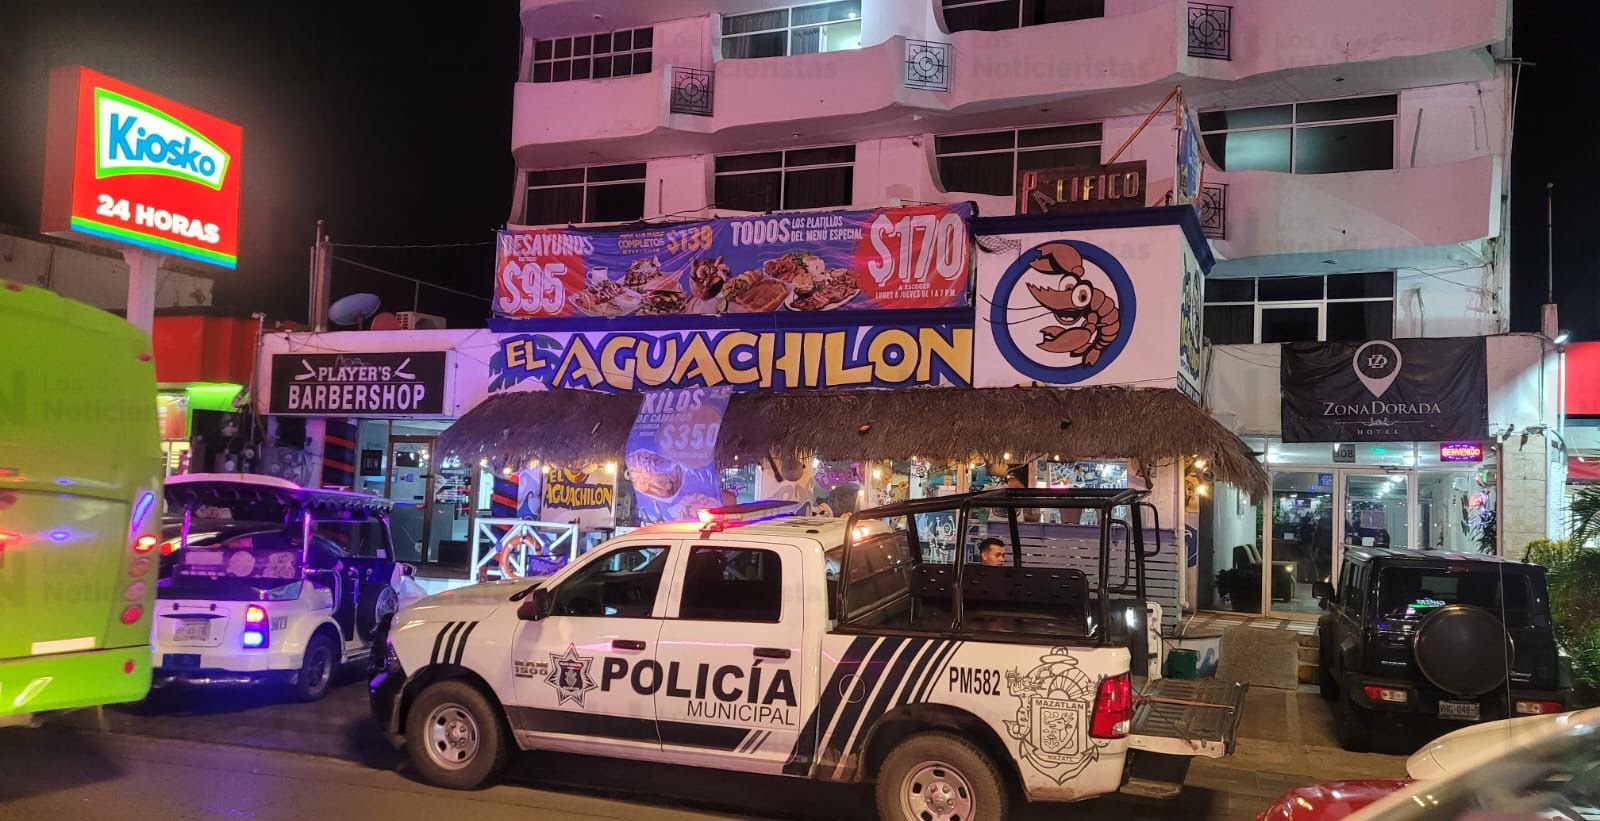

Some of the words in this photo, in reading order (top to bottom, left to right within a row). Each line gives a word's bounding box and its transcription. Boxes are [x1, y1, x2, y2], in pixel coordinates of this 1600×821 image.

[109, 113, 215, 176] Kiosko
[96, 194, 131, 221] 24
[135, 203, 220, 244] HORAS
[731, 218, 791, 246] TODOS
[792, 217, 806, 228] LOS
[807, 215, 844, 229] PLATILLOS
[501, 233, 595, 256] DESAYUNOS
[618, 238, 666, 248] COMPLETOS
[667, 225, 713, 254] $139
[791, 230, 804, 241] DEL
[829, 228, 863, 240] ESPECIAL
[868, 213, 967, 286] $170
[500, 260, 568, 314] $95
[875, 291, 894, 299] LUNES
[900, 289, 920, 298] JUEVES
[922, 289, 929, 297] DE
[506, 340, 547, 370] EL
[552, 328, 974, 389] AGUACHILON
[317, 366, 391, 382] PLAYER'S
[288, 384, 425, 410] BARBERSHOP
[641, 389, 705, 414] KILOS
[660, 422, 720, 450] $350
[549, 468, 564, 482] EL
[545, 484, 613, 507] AGUACHILON
[600, 657, 798, 707] POLICÍA
[949, 667, 1001, 696] PM582
[686, 700, 796, 726] MUNICIPAL
